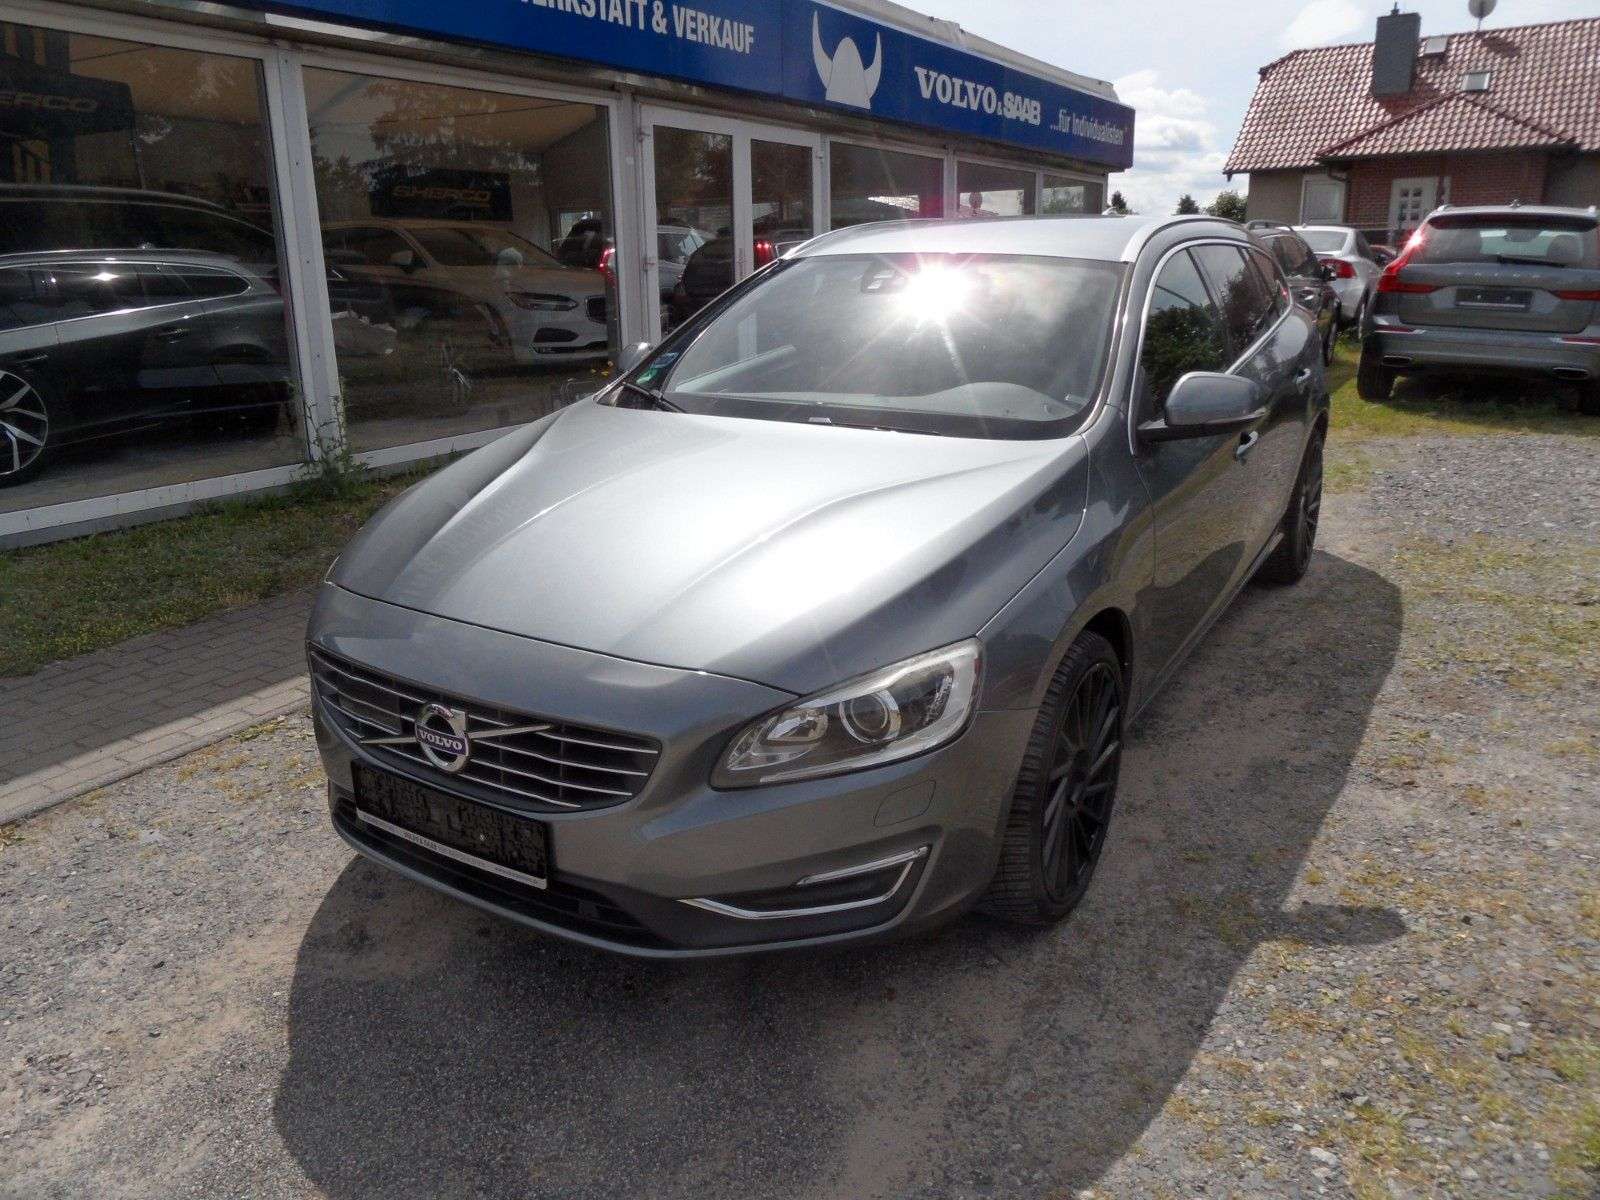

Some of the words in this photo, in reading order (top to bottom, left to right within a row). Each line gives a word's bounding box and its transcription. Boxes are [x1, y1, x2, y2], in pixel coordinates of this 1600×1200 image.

[651, 0, 668, 35] &
[672, 4, 754, 54] VERKAUF
[914, 66, 997, 115] VOLVO
[1003, 91, 1041, 126] SAAB
[420, 731, 463, 751] VOLVO
